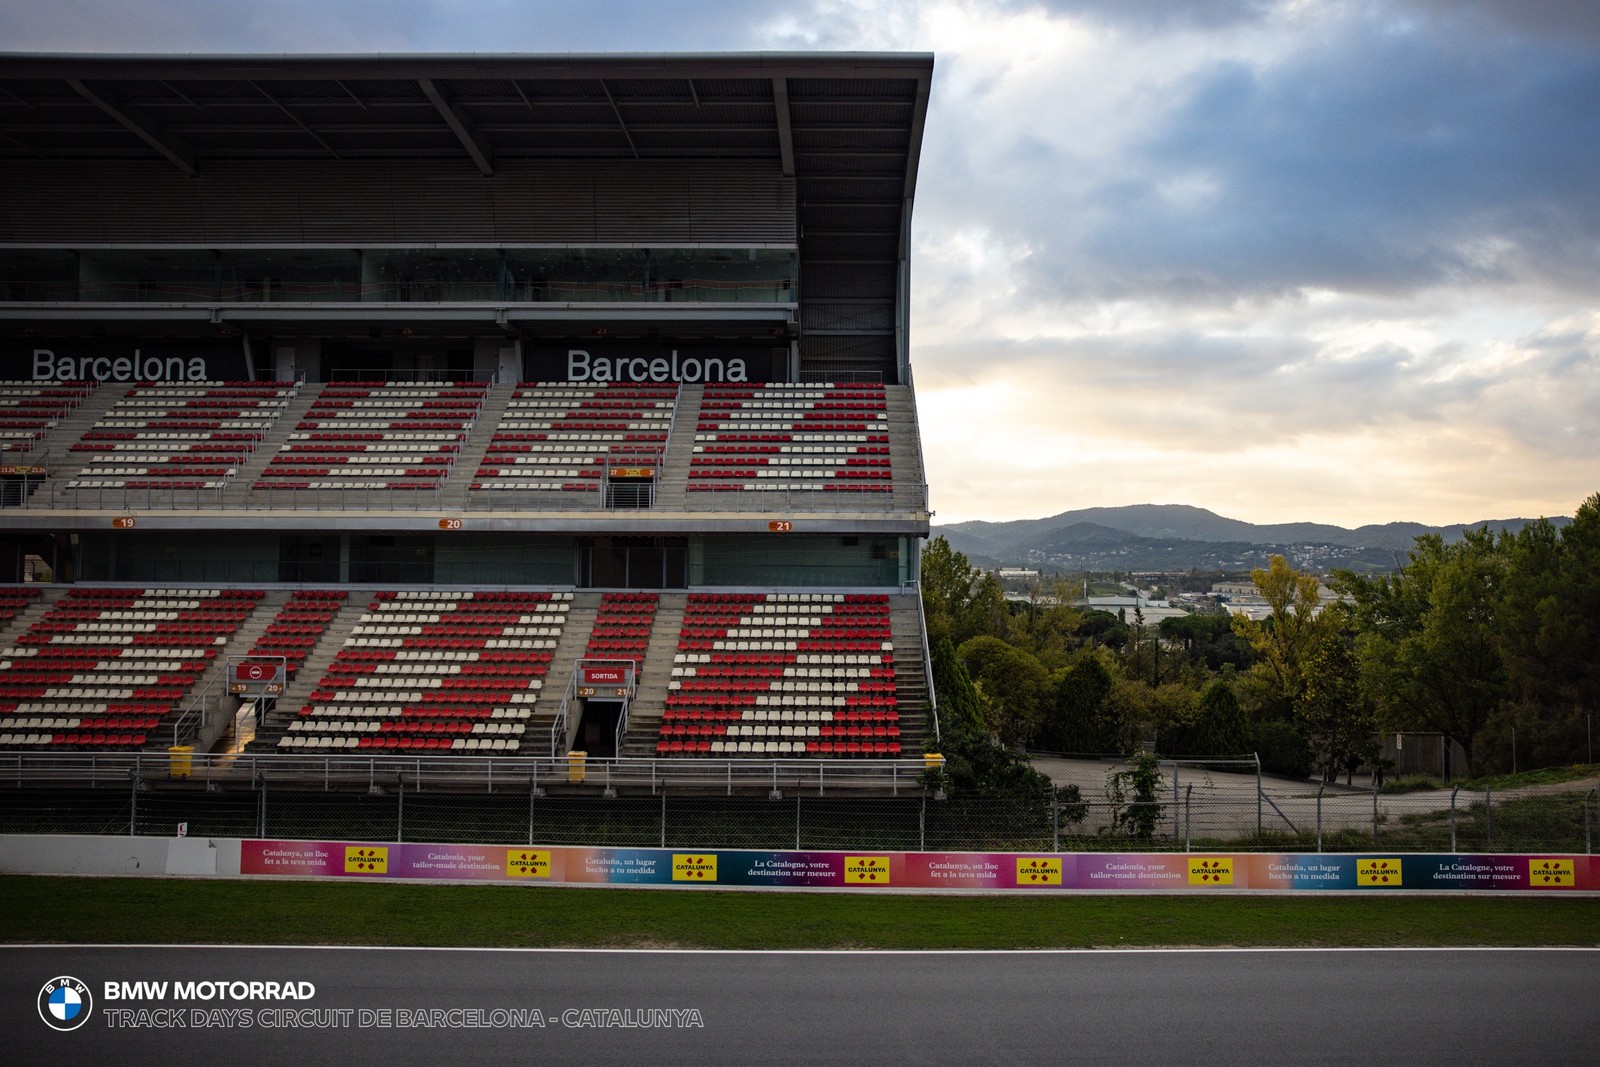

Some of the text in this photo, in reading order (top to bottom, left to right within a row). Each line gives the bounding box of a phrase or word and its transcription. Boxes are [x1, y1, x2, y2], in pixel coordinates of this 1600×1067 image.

[32, 348, 207, 380] Barcelona
[567, 350, 748, 382] Barcelona
[121, 518, 134, 527] 19
[447, 520, 460, 528] 20
[777, 522, 789, 530] 21
[262, 849, 302, 858] Catalunya,
[315, 850, 328, 858] lloc
[428, 853, 466, 861] Catalonia,
[412, 861, 500, 870] tailor-made destination
[585, 857, 623, 866] Cataluña,
[635, 858, 656, 867] lugar
[754, 860, 766, 868] La
[767, 860, 808, 870] Catalogne,
[626, 866, 655, 874] medida
[928, 862, 970, 871] Catalunya,
[984, 862, 998, 870] lloc
[1105, 863, 1146, 871] Catalonia,
[1268, 864, 1306, 872] Cataluña,
[1320, 864, 1340, 872] lugar
[1451, 864, 1493, 872] Catalogne,
[747, 869, 791, 877] destination
[1138, 871, 1181, 879] destination
[1310, 872, 1340, 880] medida
